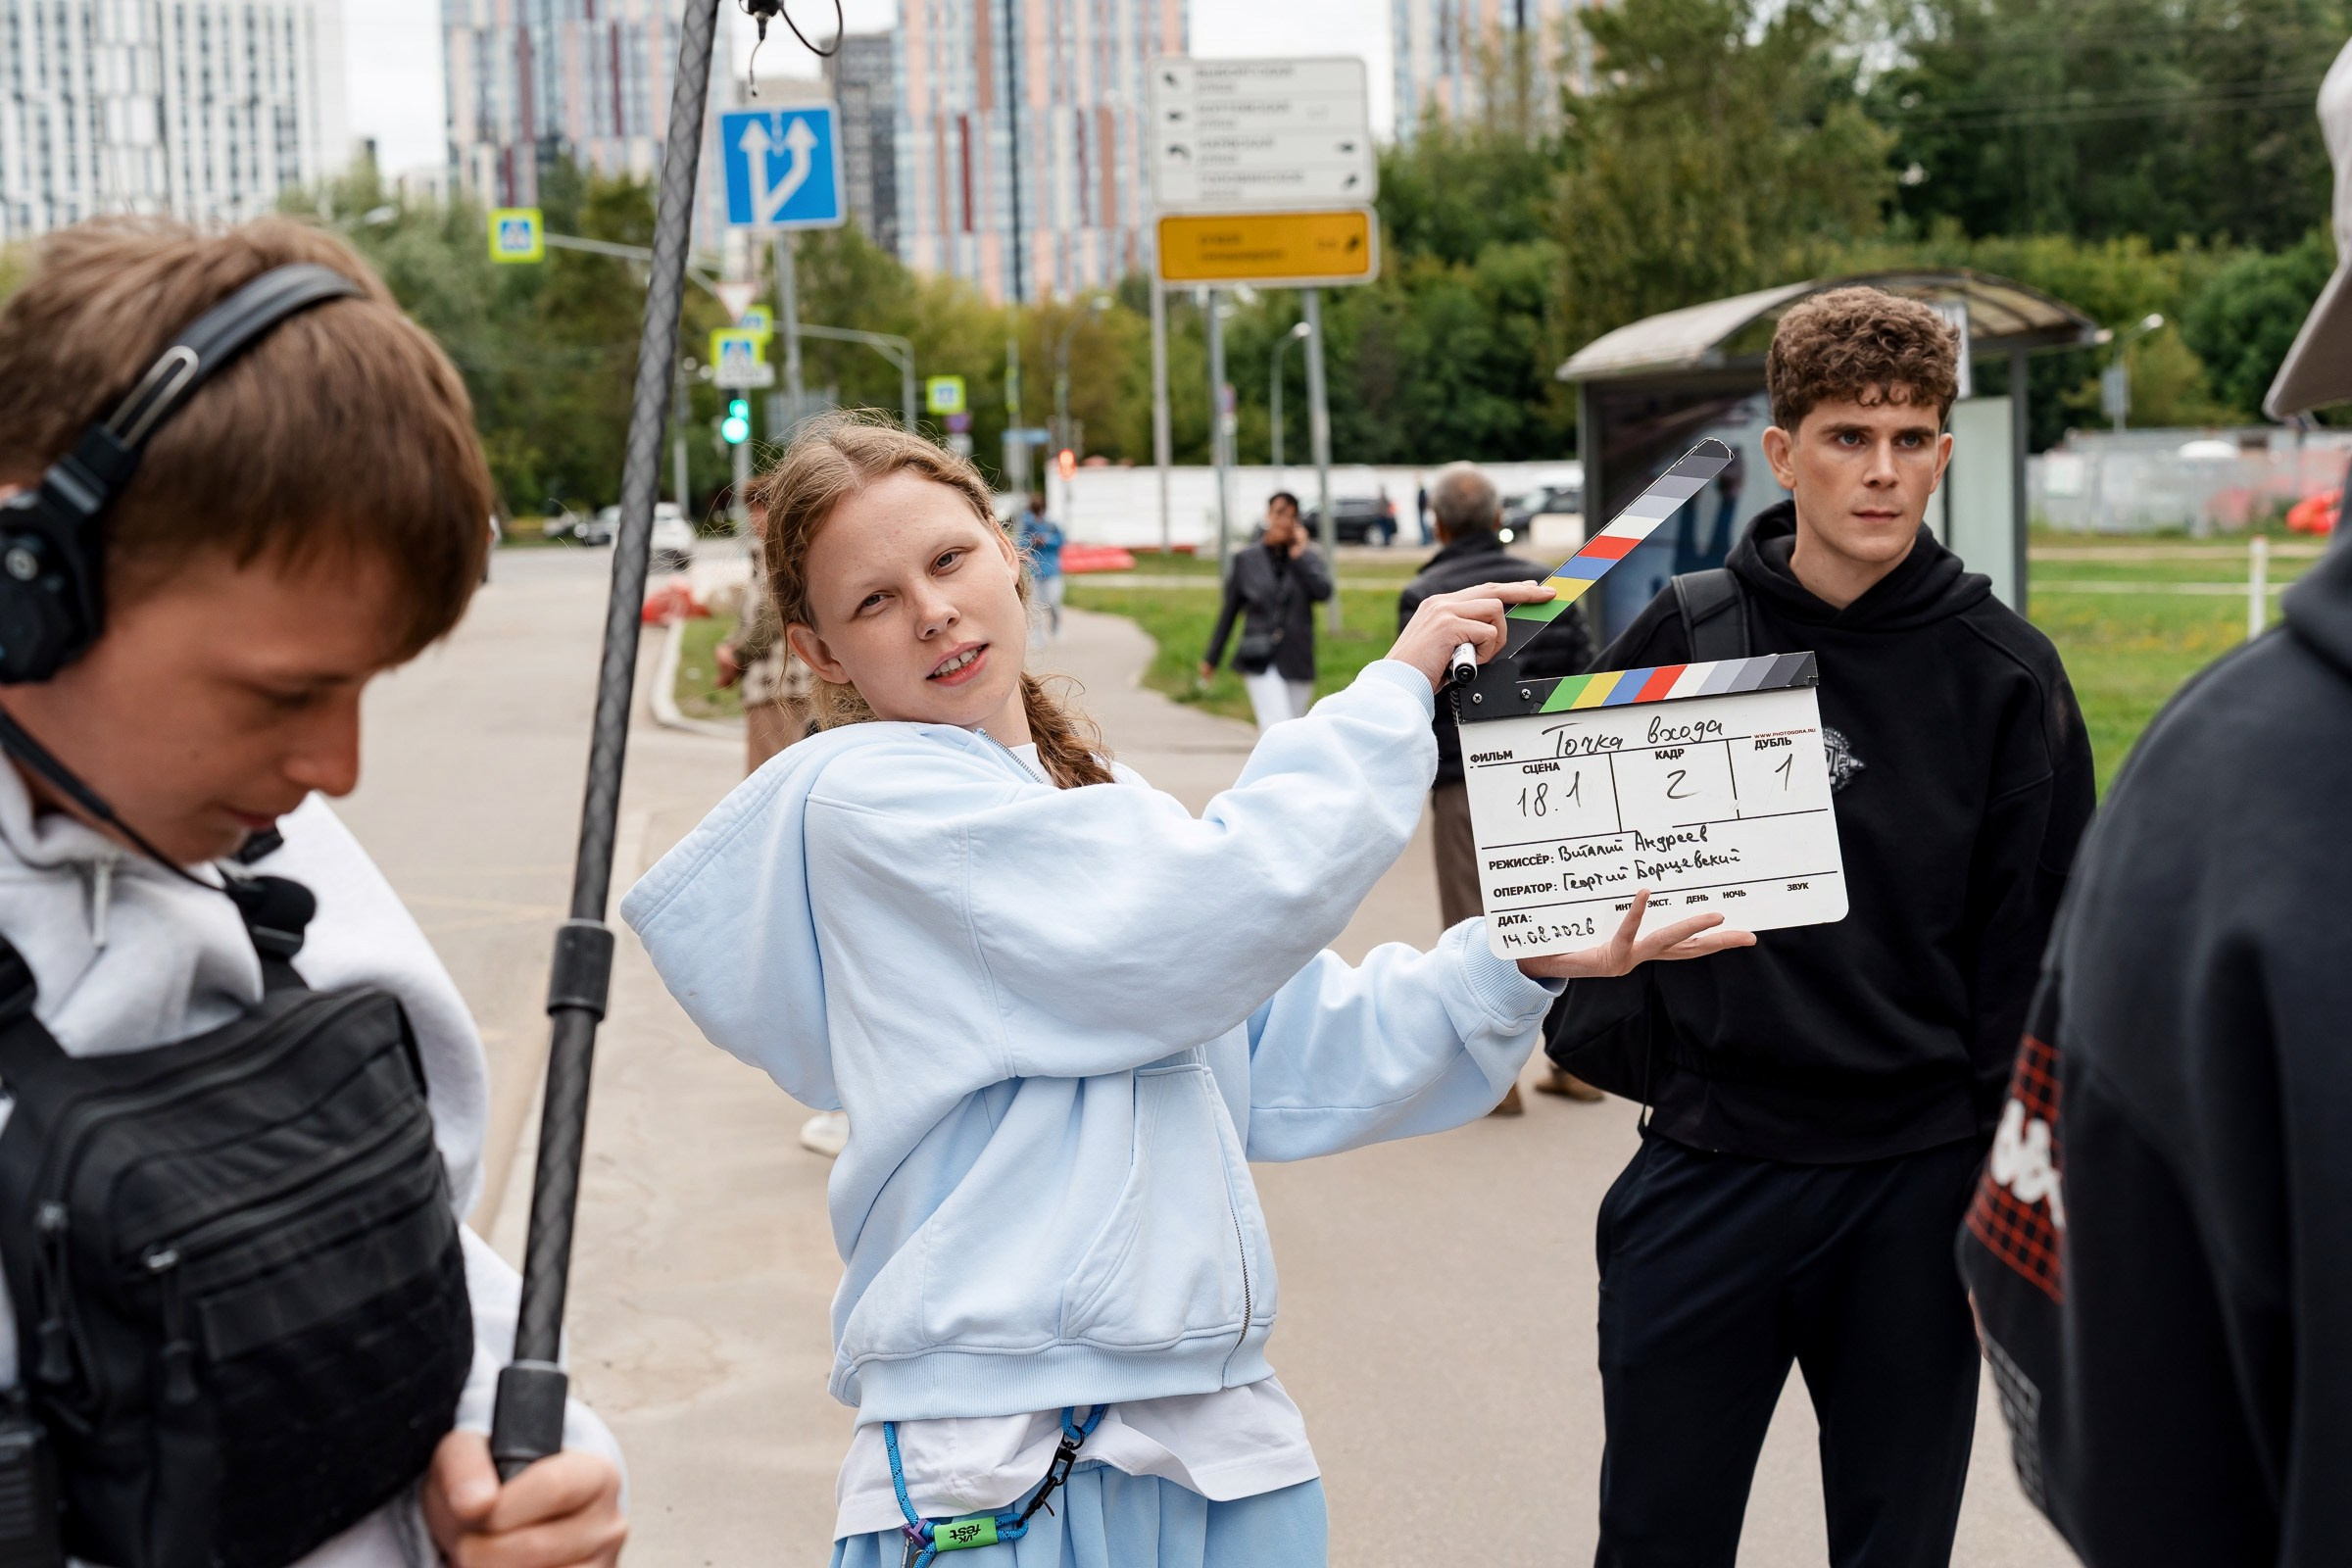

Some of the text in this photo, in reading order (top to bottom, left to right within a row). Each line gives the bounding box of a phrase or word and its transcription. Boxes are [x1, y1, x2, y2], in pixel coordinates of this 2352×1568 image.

[1542, 715, 1723, 759] Точка входа
[1754, 737, 1792, 751] ДУБЛЬ
[1470, 751, 1513, 763] ФИЛЬМ
[1655, 748, 1685, 760] КАДР
[1522, 761, 1560, 774] СЦЕНА
[1775, 753, 1793, 792] 1
[1666, 769, 1701, 799] 2
[1517, 770, 1581, 817] 18.1
[1635, 824, 1708, 853] Андреев
[1489, 853, 1555, 870] РЕЖИССЁР:
[1494, 882, 1558, 898] ОПЕРАТОР:
[1787, 882, 1810, 892] ЗВУК
[1686, 894, 1709, 905] ДЕНЬ
[1722, 890, 1747, 900] НОЧЬ
[1647, 899, 1672, 908] ЭКСТ.
[1497, 913, 1533, 928] ДАТА:
[949, 1524, 981, 1540] fest
[958, 1534, 973, 1544] VK
